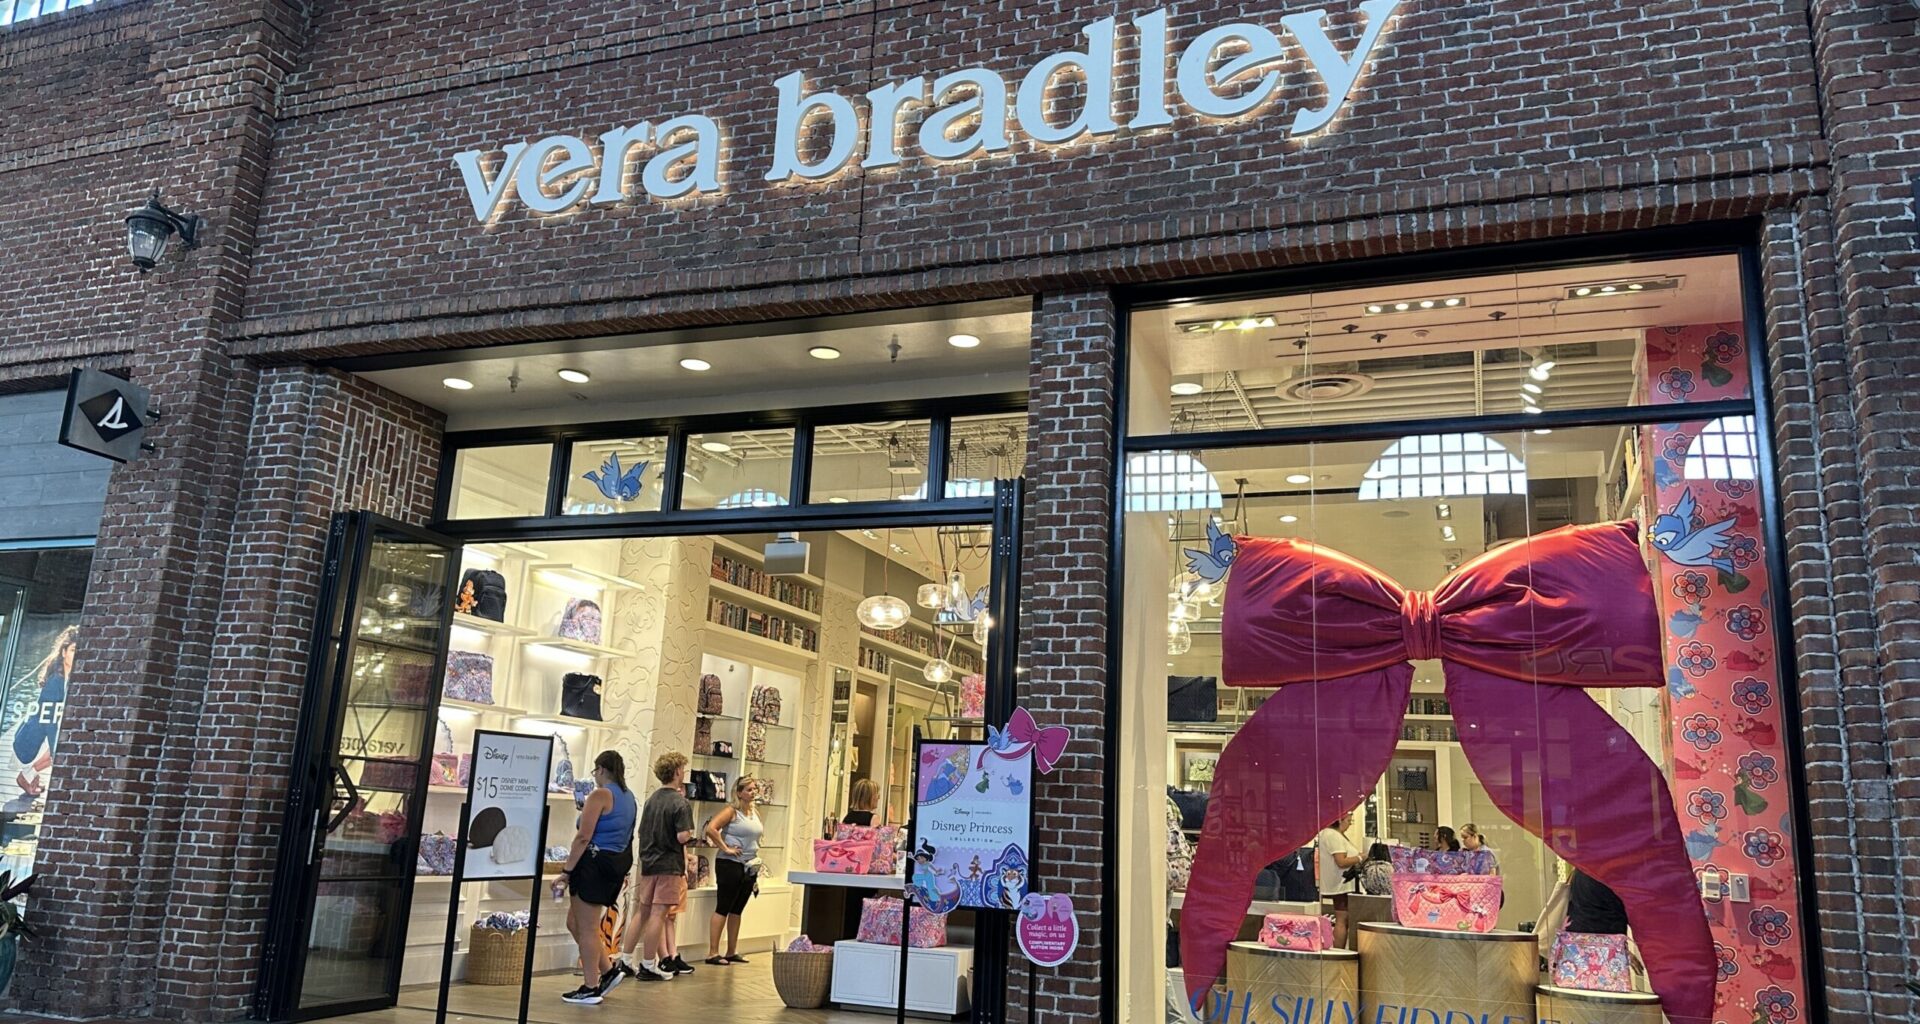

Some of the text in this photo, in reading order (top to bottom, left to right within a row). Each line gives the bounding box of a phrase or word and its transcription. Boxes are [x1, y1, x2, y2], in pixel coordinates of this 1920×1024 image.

[453, 0, 1402, 223] vera bradley
[483, 745, 509, 764] Disney
[476, 776, 499, 799] $15
[931, 820, 1013, 835] Disney Princess
[1026, 923, 1047, 931] Collect
[1271, 994, 1366, 1024] SILLY
